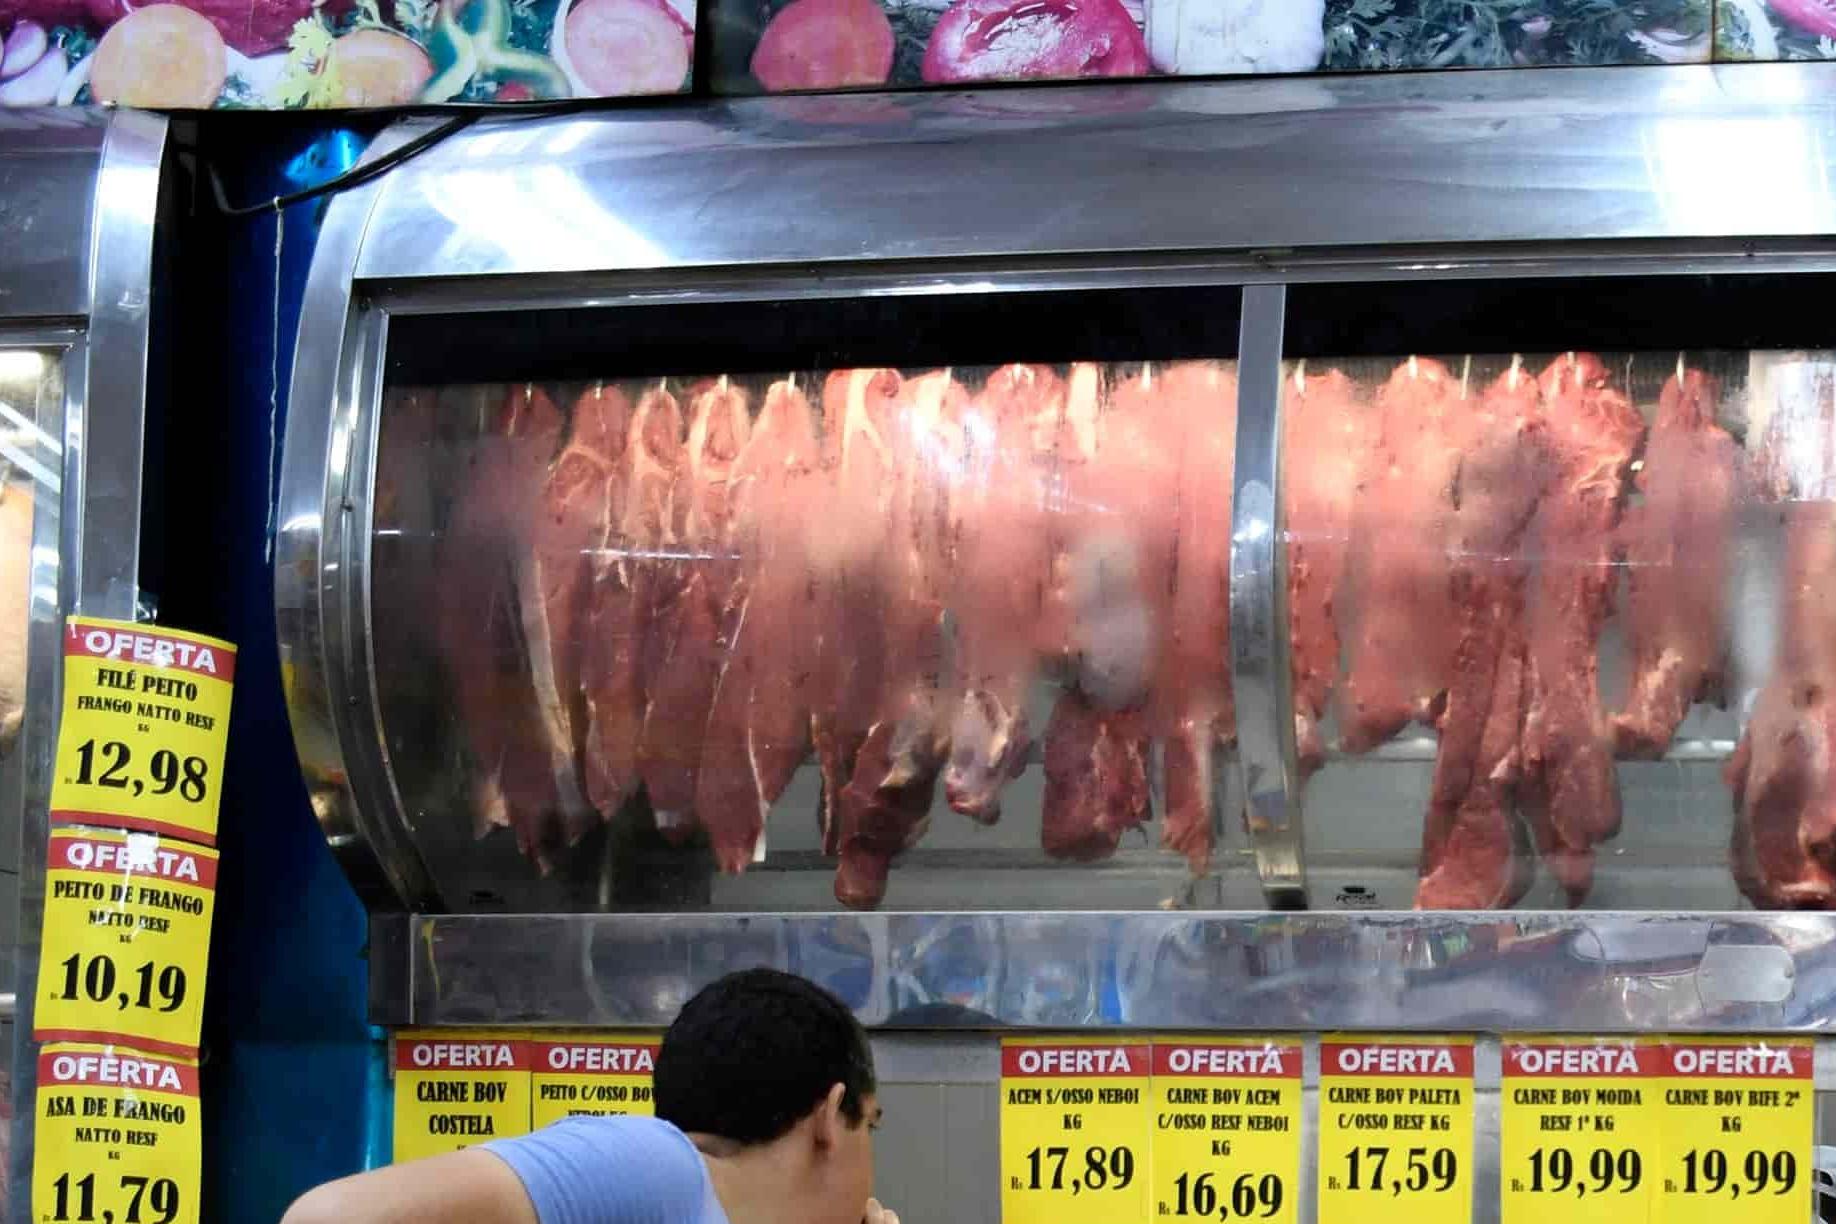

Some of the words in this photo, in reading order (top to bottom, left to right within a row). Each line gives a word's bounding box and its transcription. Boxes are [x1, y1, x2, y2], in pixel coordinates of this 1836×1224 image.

[85, 631, 216, 672] OFERTA
[97, 667, 136, 691] FILÉ
[143, 675, 197, 702] PEITO
[78, 695, 131, 715] FRANGO
[137, 703, 180, 723] NATTO
[186, 712, 215, 732] RESF
[76, 738, 208, 803] 12,98
[54, 880, 105, 901] PEITO
[109, 884, 134, 904] DE
[138, 887, 204, 917] FRANGO
[89, 910, 134, 928] NATTO
[139, 914, 170, 934] RESF
[61, 952, 187, 1012] 10,19
[413, 1043, 515, 1068] OFERTA
[548, 1046, 654, 1072] OFERTA
[1018, 1048, 1132, 1074] OFERTA
[1168, 1049, 1283, 1074] OFERTA
[1338, 1048, 1456, 1073] OFERTA
[1520, 1049, 1639, 1074] OFERTA
[1673, 1049, 1794, 1074] OFERTA
[53, 1056, 181, 1091] OFERTA
[416, 1081, 469, 1103] CARNE
[473, 1081, 507, 1103] BOV
[541, 1085, 577, 1101] PEITO
[581, 1085, 628, 1102] C/OSSO
[1008, 1088, 1042, 1106] ACEM
[1046, 1088, 1093, 1106] S/OSSO
[1098, 1088, 1140, 1106] NEBOI
[1167, 1088, 1208, 1106] CARNE
[1213, 1088, 1241, 1106] BOV
[1246, 1089, 1281, 1106] ACEM
[1328, 1087, 1371, 1105] CARNE
[1376, 1088, 1405, 1105] BOV
[1409, 1088, 1461, 1106] PALETA
[1513, 1089, 1557, 1106] CARNE
[1562, 1089, 1592, 1106] BOV
[1596, 1089, 1642, 1107] MOIDA
[1665, 1089, 1709, 1107] CARNE
[1714, 1090, 1743, 1107] BOV
[1747, 1090, 1779, 1107] BIFE
[47, 1096, 75, 1118] ASA
[83, 1096, 107, 1117] DE
[113, 1098, 185, 1126] FRANGO
[1063, 1113, 1082, 1131] KG
[1158, 1113, 1207, 1132] C/OSSO
[1211, 1114, 1242, 1132] RESF
[1247, 1114, 1290, 1133] NEBOI
[1338, 1113, 1389, 1131] C/OSSO
[1394, 1113, 1425, 1131] RESF
[1430, 1114, 1451, 1132] KG
[1540, 1114, 1572, 1132] RESF
[1594, 1115, 1615, 1132] KG
[75, 1127, 121, 1144] NATTO
[126, 1129, 158, 1147] RESF
[428, 1114, 494, 1136] COSTELA
[1721, 1116, 1741, 1133] KG
[108, 1151, 121, 1160] KG
[1211, 1139, 1231, 1157] KG
[1026, 1146, 1134, 1196] 17,89
[1345, 1146, 1458, 1197] 17,59
[1528, 1147, 1642, 1199] 19,99
[1682, 1148, 1797, 1201] 19,99
[1174, 1170, 1284, 1222] 16,69
